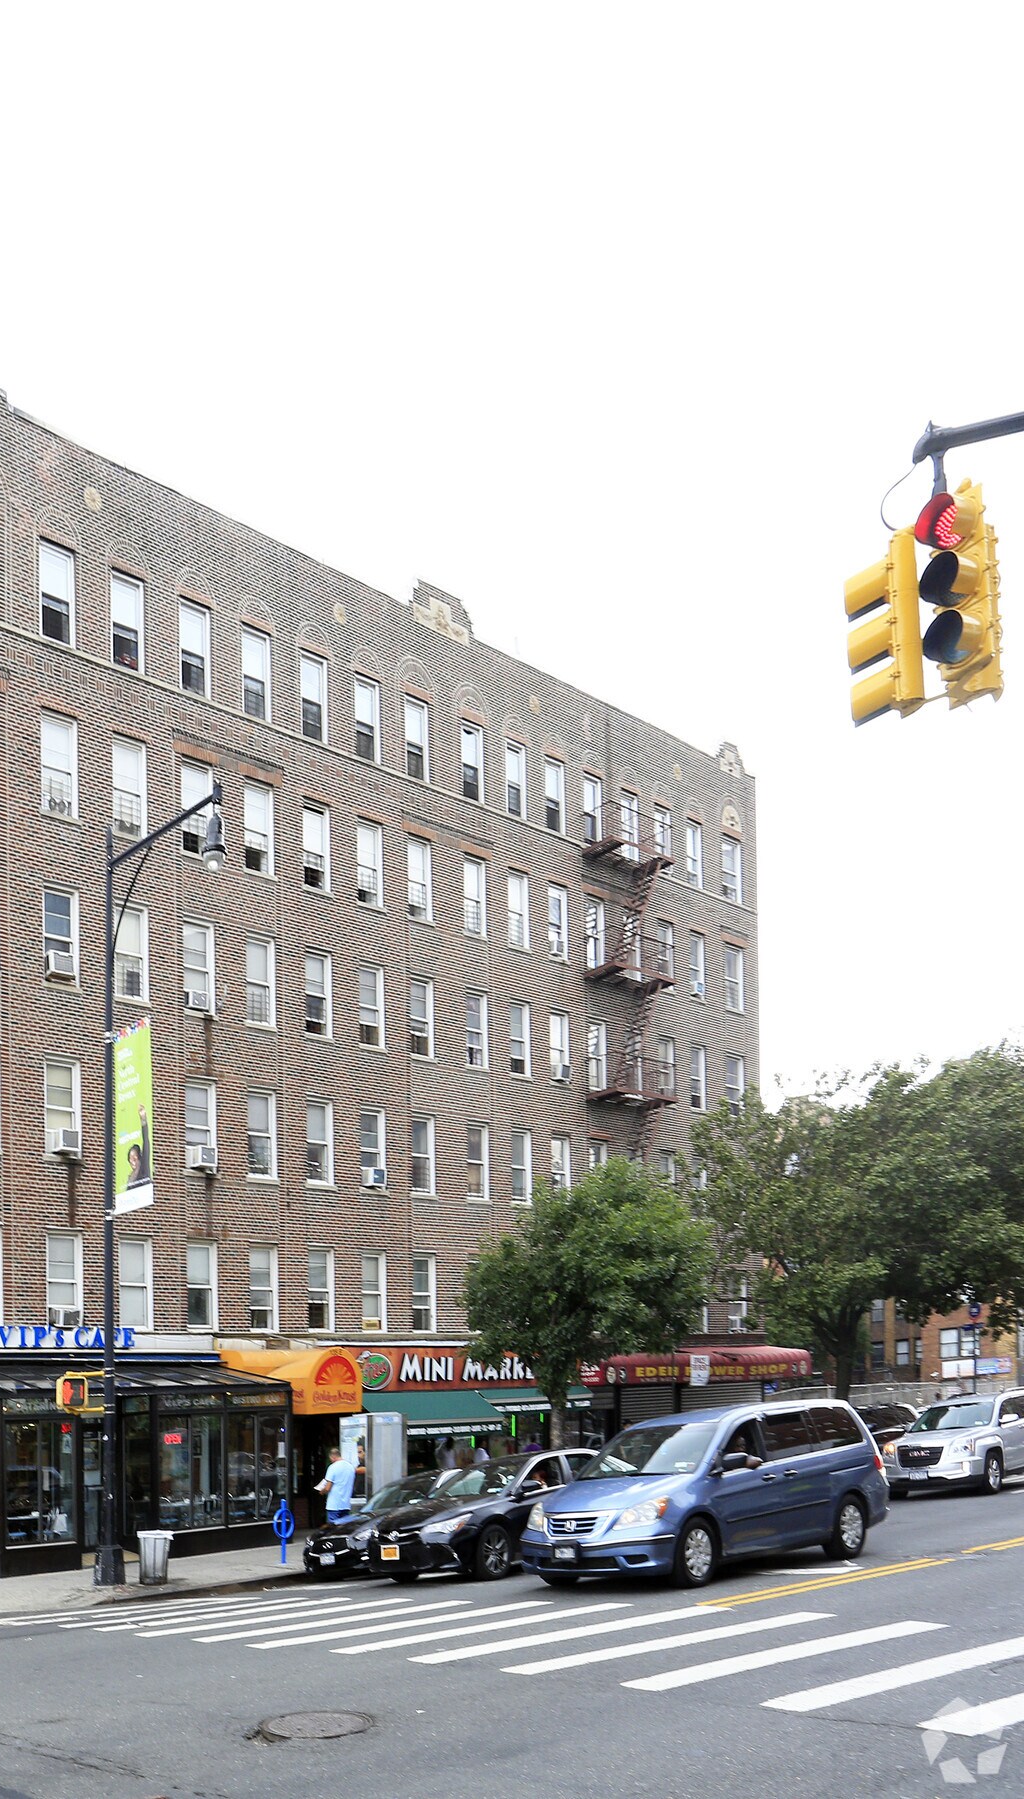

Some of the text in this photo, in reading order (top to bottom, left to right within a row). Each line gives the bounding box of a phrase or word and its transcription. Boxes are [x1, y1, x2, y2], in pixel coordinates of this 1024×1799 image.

[462, 1356, 535, 1382] MARK
[635, 1363, 788, 1378] EDEN FWER SHOP
[16, 1399, 56, 1411] CATERIN
[163, 1433, 182, 1444] OPEN
